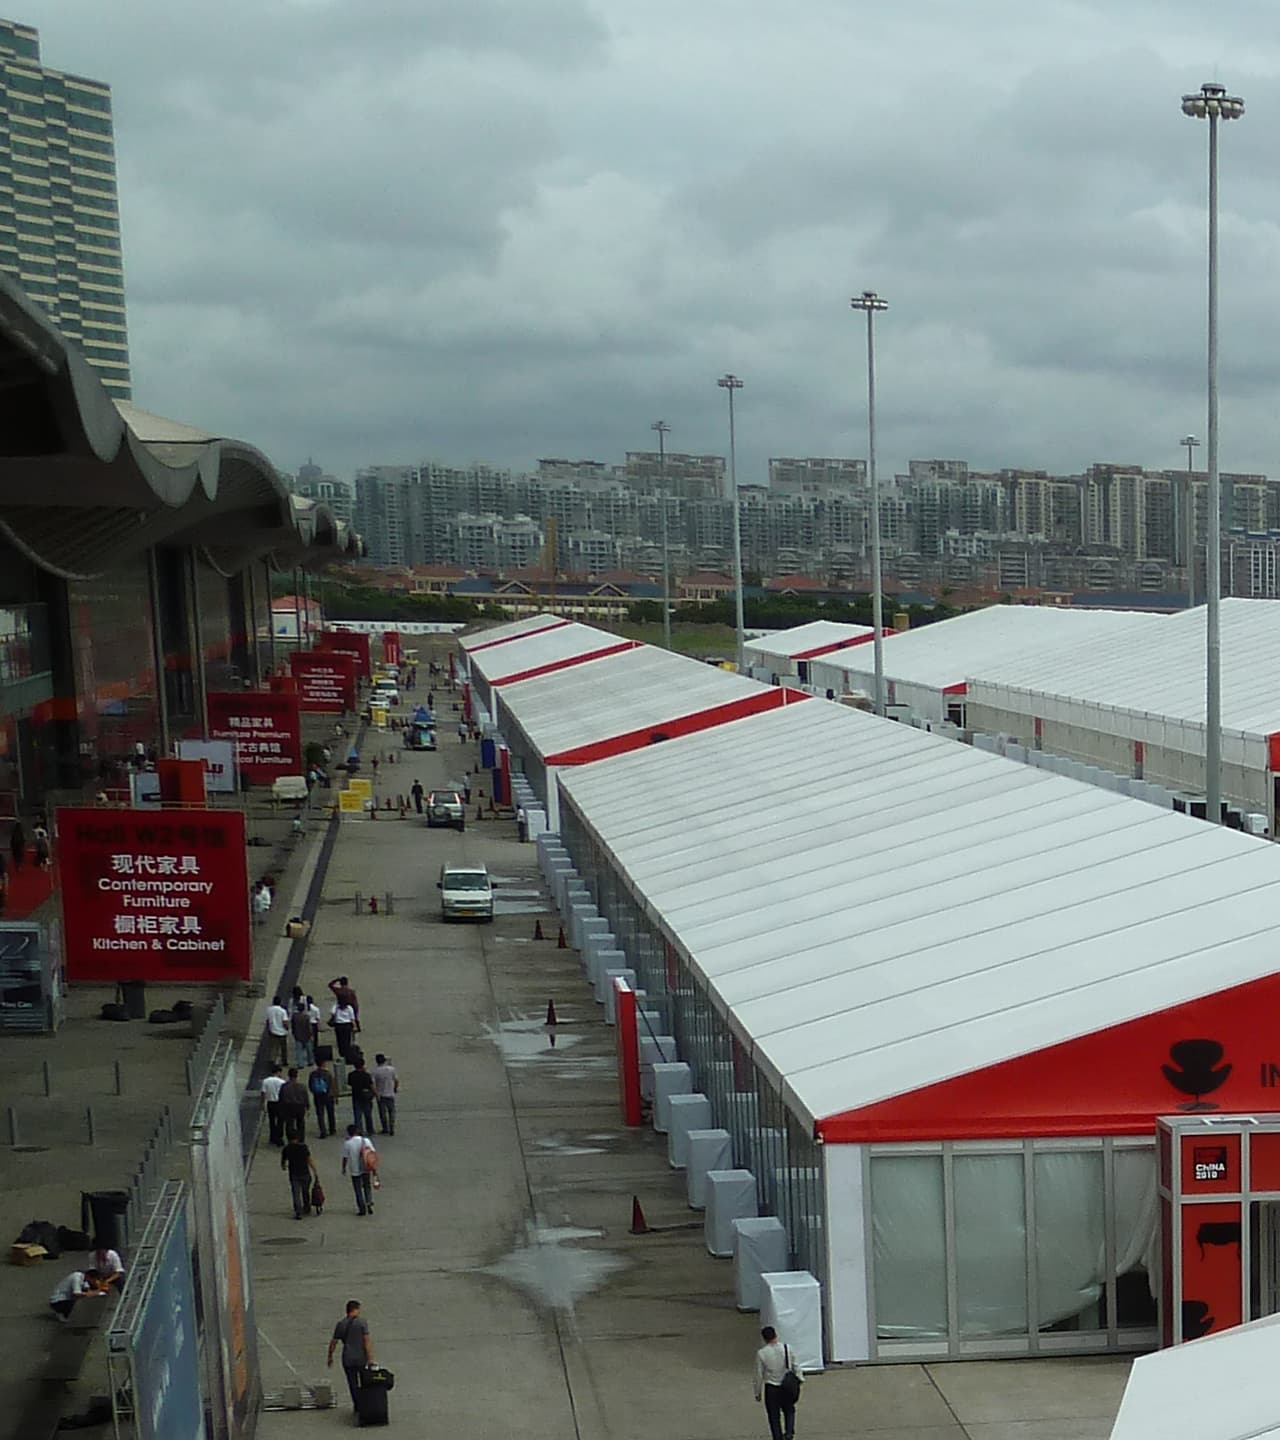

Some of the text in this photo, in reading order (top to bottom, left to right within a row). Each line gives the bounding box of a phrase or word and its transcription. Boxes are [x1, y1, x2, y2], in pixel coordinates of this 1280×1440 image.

[111, 854, 201, 875] 现代家具
[98, 878, 213, 894] Contemporary
[122, 895, 191, 908] Furniture
[113, 914, 203, 935] 橱柜家具
[92, 937, 225, 951] Kitchen & Cabinet
